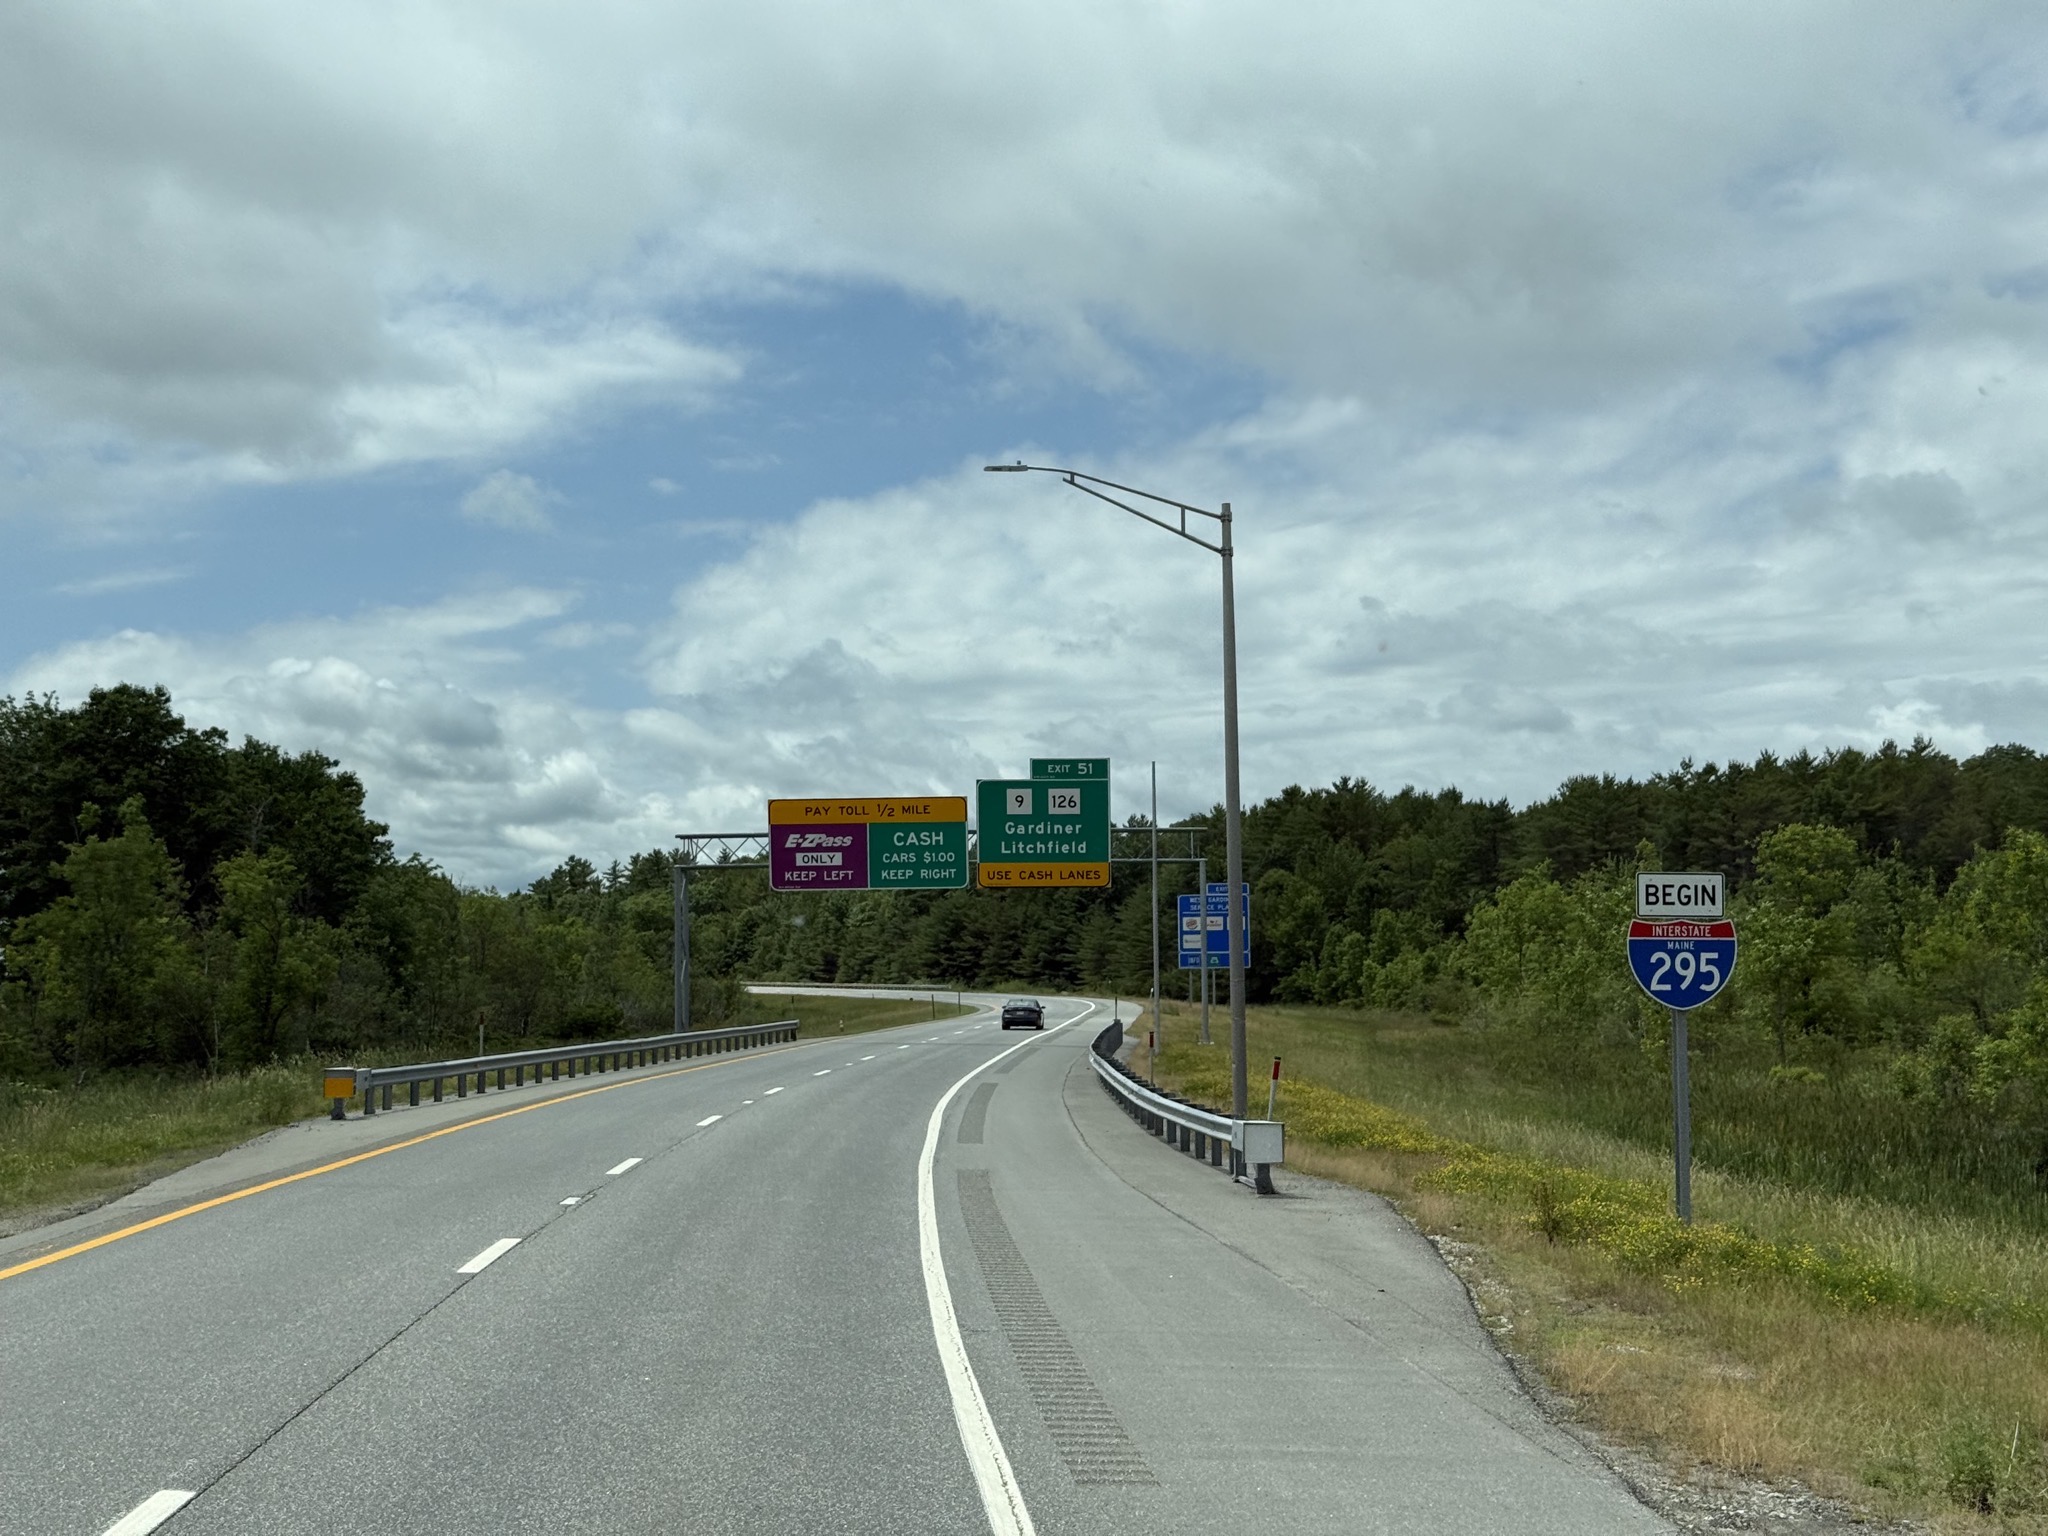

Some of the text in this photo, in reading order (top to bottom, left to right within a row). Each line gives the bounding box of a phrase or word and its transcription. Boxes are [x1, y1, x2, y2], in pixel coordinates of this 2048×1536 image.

[1047, 763, 1093, 774] EXIT 51
[1014, 795, 1024, 808] 9
[1051, 795, 1077, 808] 126
[805, 806, 831, 816] PAY
[839, 806, 869, 815] TOLL
[902, 805, 930, 814] MILE
[1005, 822, 1082, 834] Gardiner
[893, 832, 943, 846] CASH
[1001, 841, 1087, 854] Litchfield
[802, 854, 836, 864] ONLY
[882, 851, 955, 864] CARS $1.00
[784, 870, 853, 881] KEEP LEFT
[881, 869, 956, 880] KEEP RIGHT
[987, 870, 1101, 880] USE CASH LANES
[1645, 884, 1716, 906] BEGIN
[1652, 925, 1711, 936] INTERSTATE
[1667, 941, 1695, 950] MAINE
[1650, 951, 1720, 992] 295
